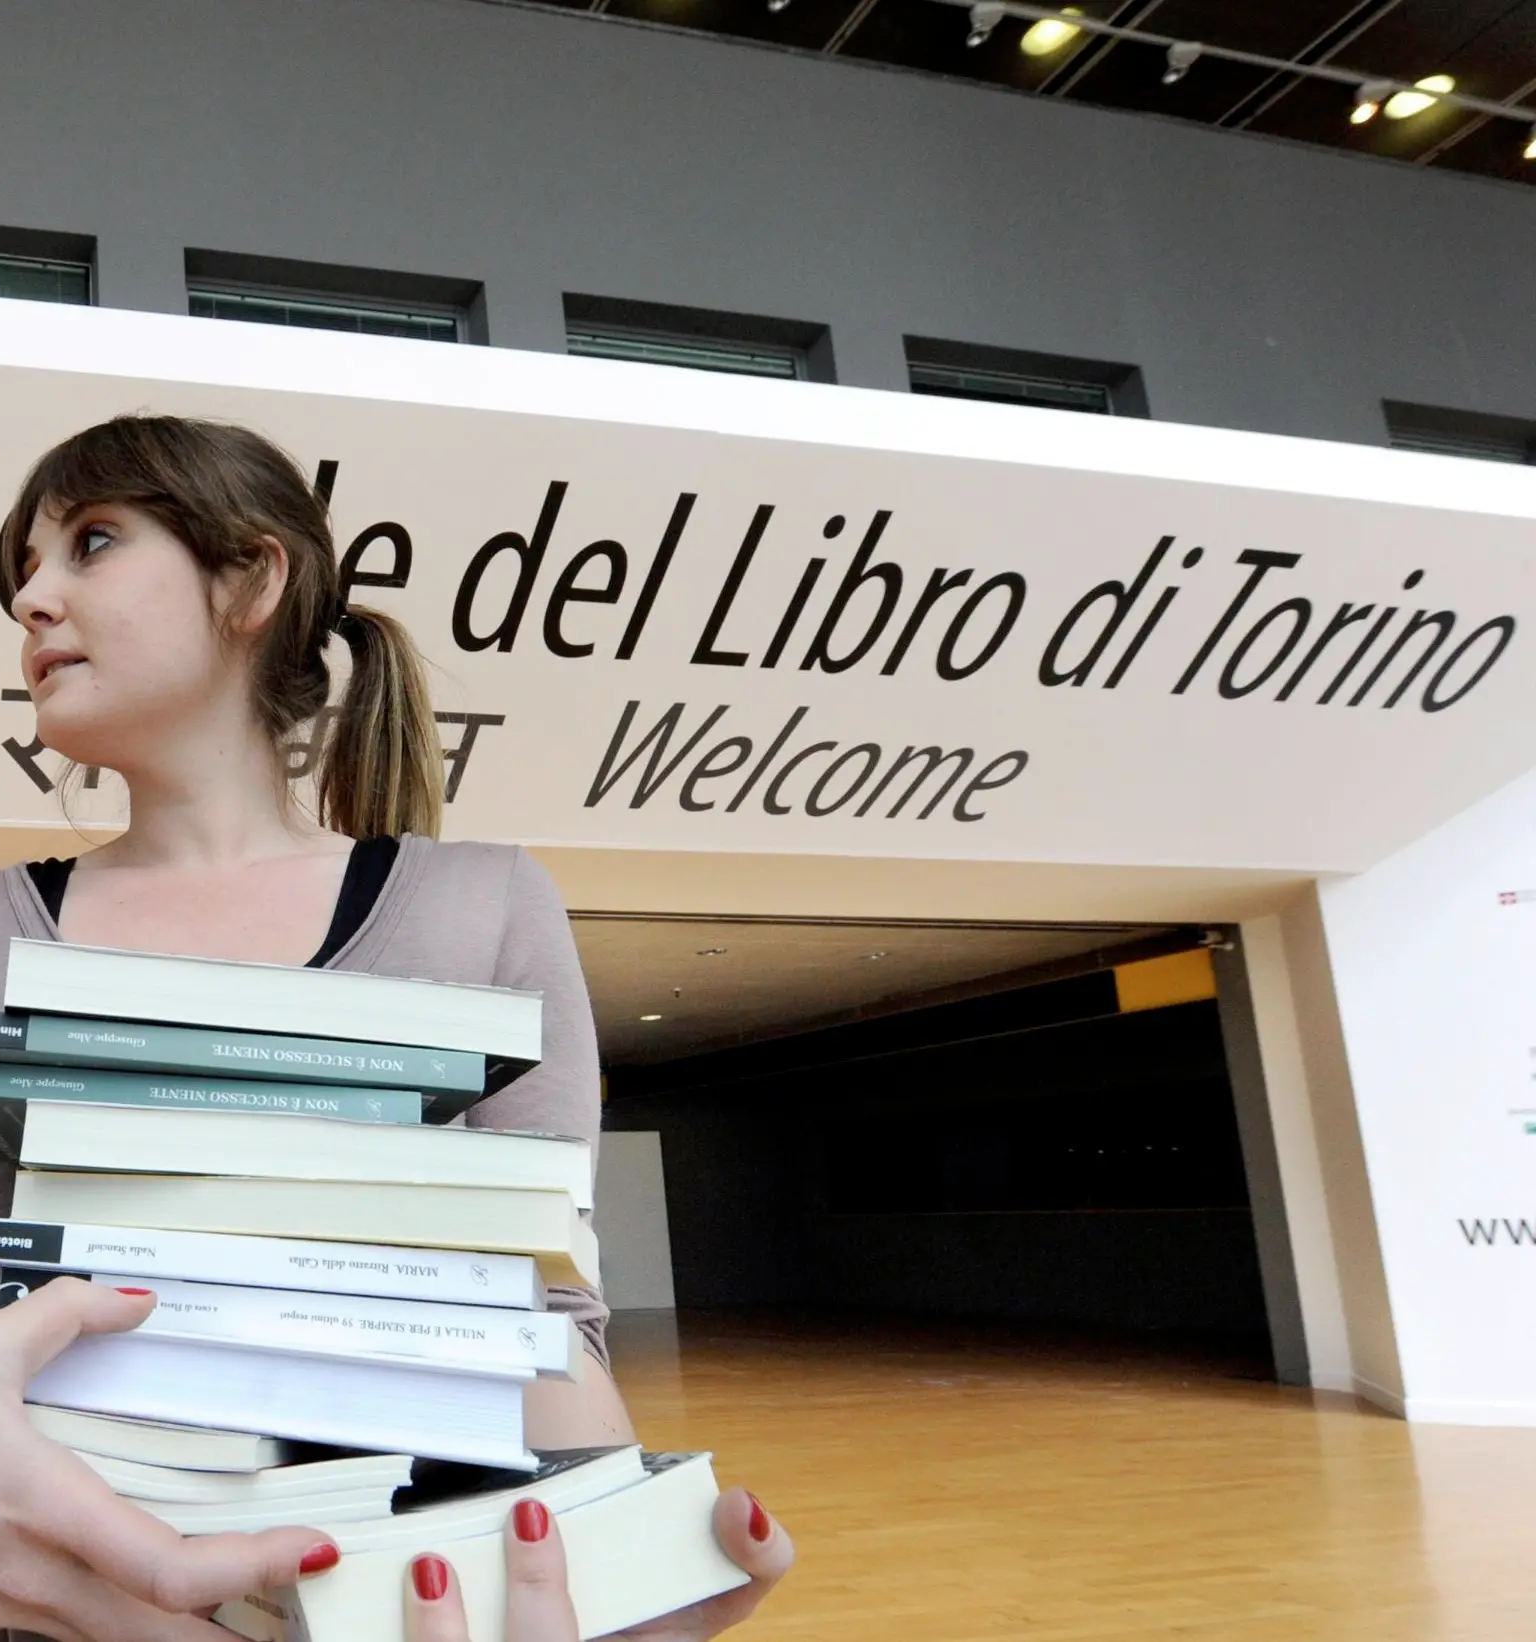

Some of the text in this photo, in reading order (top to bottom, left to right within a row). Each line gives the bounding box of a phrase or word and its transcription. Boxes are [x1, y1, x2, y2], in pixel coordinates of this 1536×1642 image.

[451, 481, 698, 660] del
[690, 504, 1027, 681] Libro
[1037, 535, 1204, 689] di
[1172, 548, 1517, 713] Torino
[583, 700, 1029, 822] Welcome
[94, 1032, 146, 1048] Giuseppe
[211, 1044, 404, 1072] NON È SUCCESSO NIENTE
[9, 1077, 85, 1092] Giuseppe Aloe
[149, 1087, 340, 1112] NON È SUCCESSO NIENTE
[86, 1243, 156, 1258] Nadia Stancioff
[288, 1256, 319, 1269] Callas
[322, 1258, 346, 1271] della
[394, 1263, 439, 1278] MARIA.
[342, 1318, 354, 1328] 59
[408, 1323, 431, 1336] PER
[445, 1326, 486, 1341] NULLA
